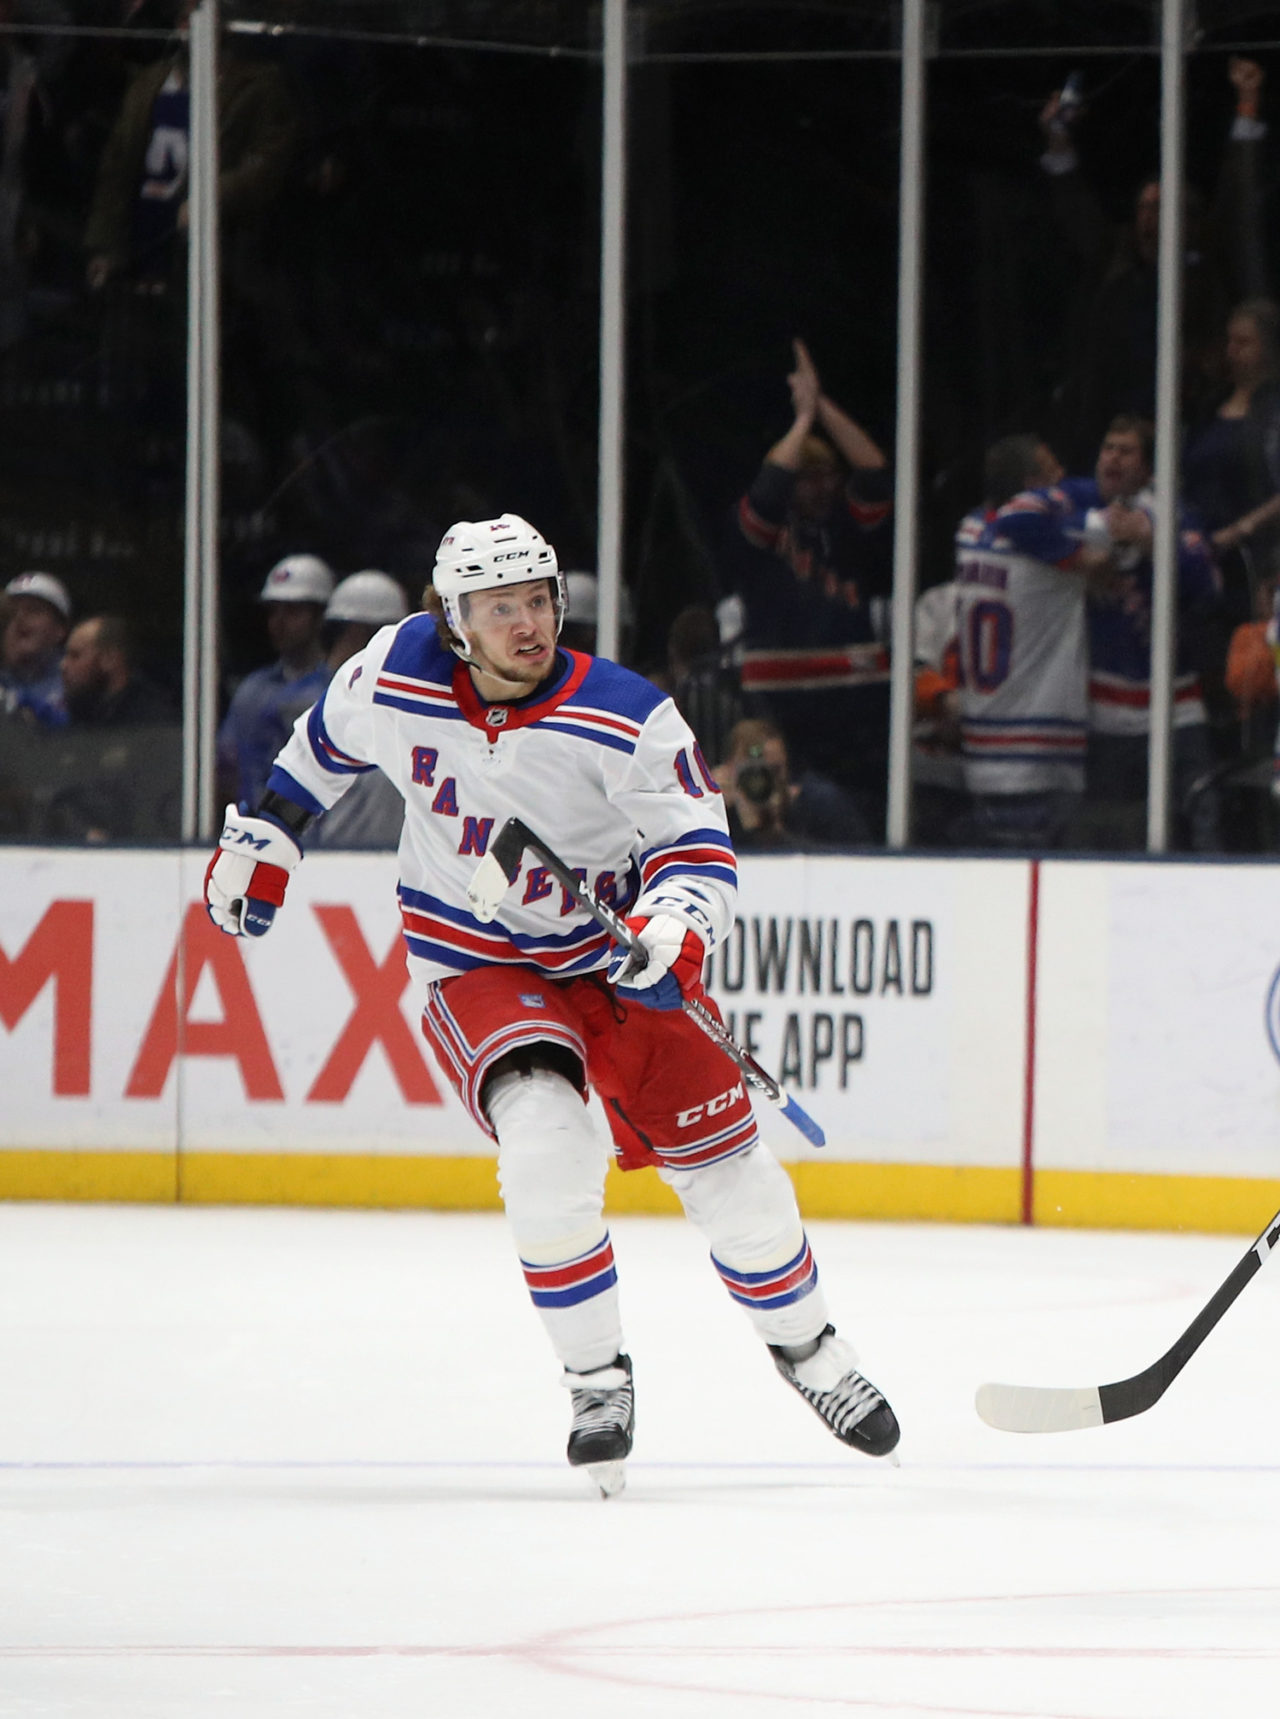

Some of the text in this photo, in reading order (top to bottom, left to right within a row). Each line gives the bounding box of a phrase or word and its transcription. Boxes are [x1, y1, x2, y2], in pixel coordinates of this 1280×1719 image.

[493, 551, 530, 563] CCM
[221, 826, 272, 851] CM
[411, 746, 619, 918] RANERS
[780, 1012, 865, 1090] APP
[675, 1081, 745, 1129] CCM
